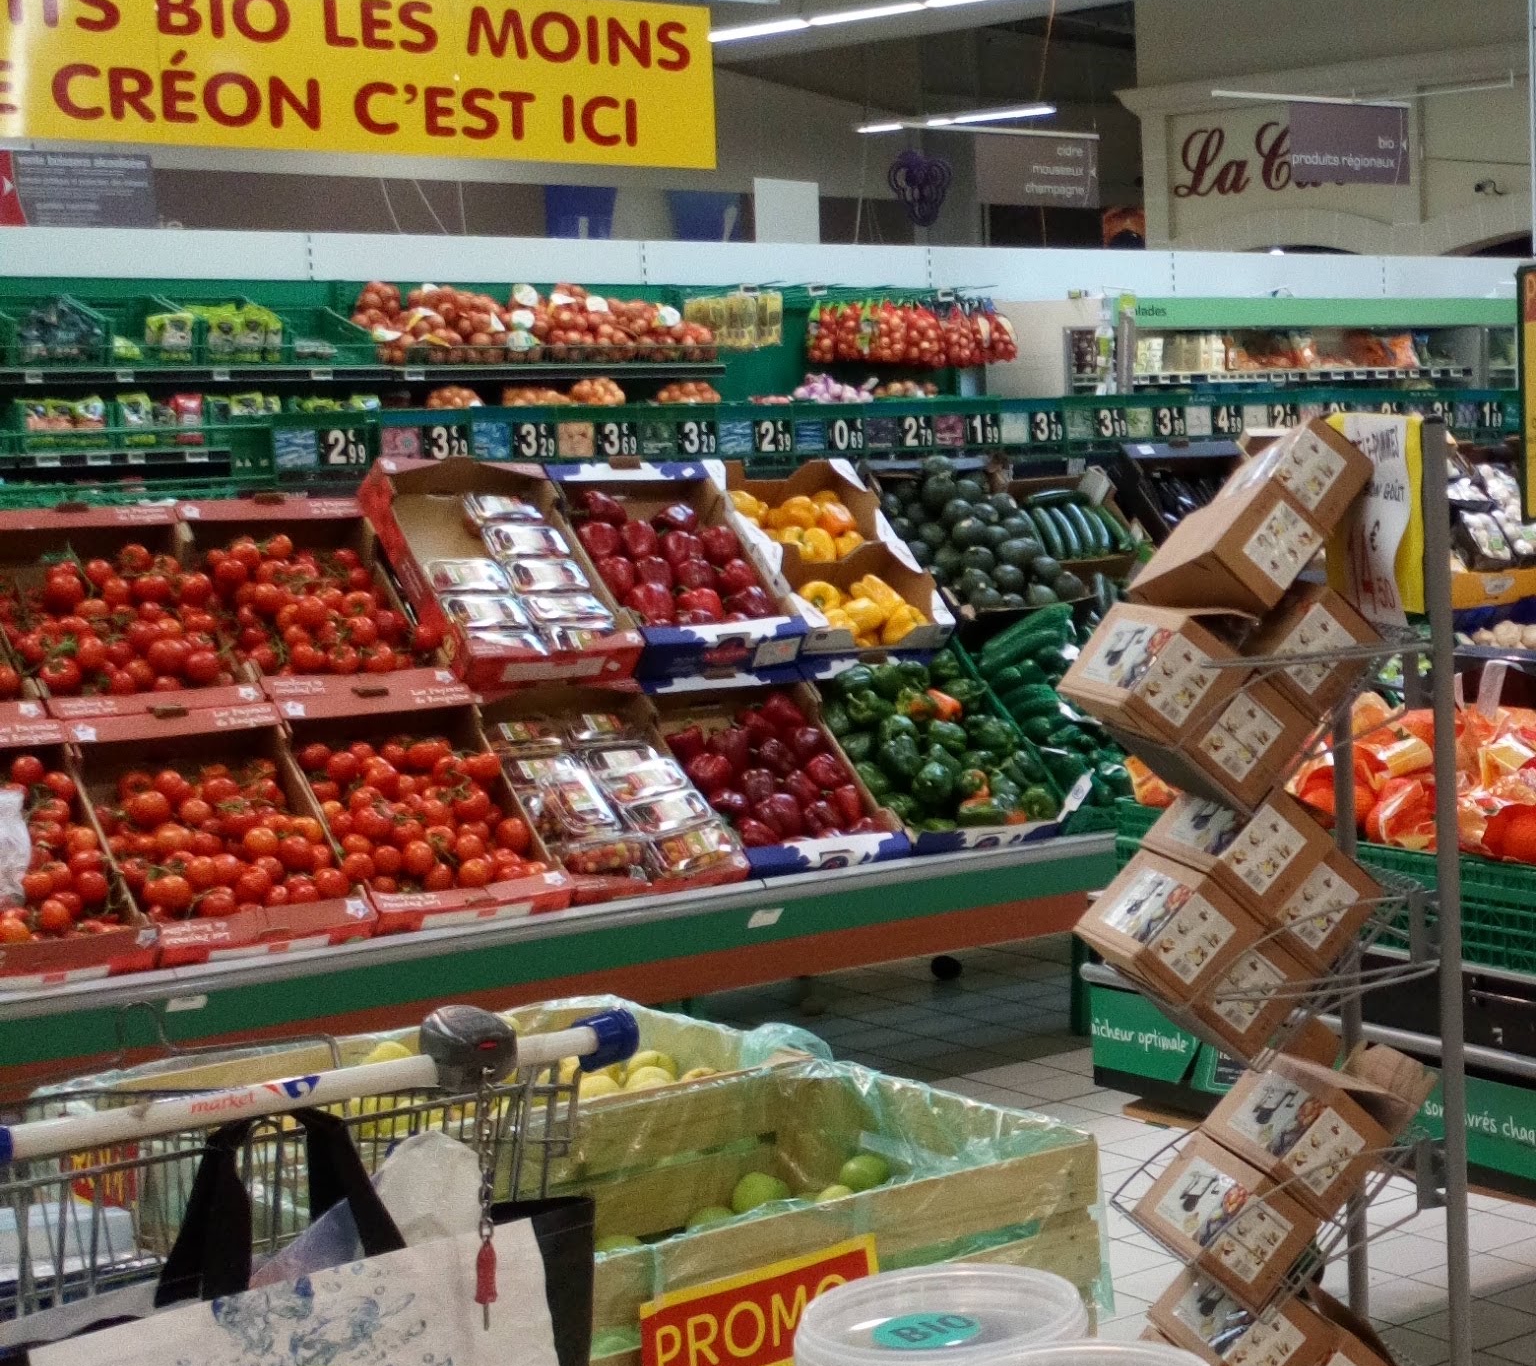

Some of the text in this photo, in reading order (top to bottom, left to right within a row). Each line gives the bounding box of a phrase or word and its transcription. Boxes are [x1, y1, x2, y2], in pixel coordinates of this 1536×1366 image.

[466, 6, 691, 72] MOINS
[51, 49, 322, 132] CRÉON
[353, 81, 536, 141] C'EST
[562, 94, 638, 147] ICI
[1056, 145, 1084, 157] cidre
[1378, 136, 1395, 150] bio
[1174, 128, 1250, 198] La
[1292, 153, 1395, 171] produits régionaux
[1025, 182, 1085, 199] champagne
[1138, 1028, 1190, 1053] optimale
[190, 1091, 257, 1115] market
[887, 1314, 976, 1344] BIO
